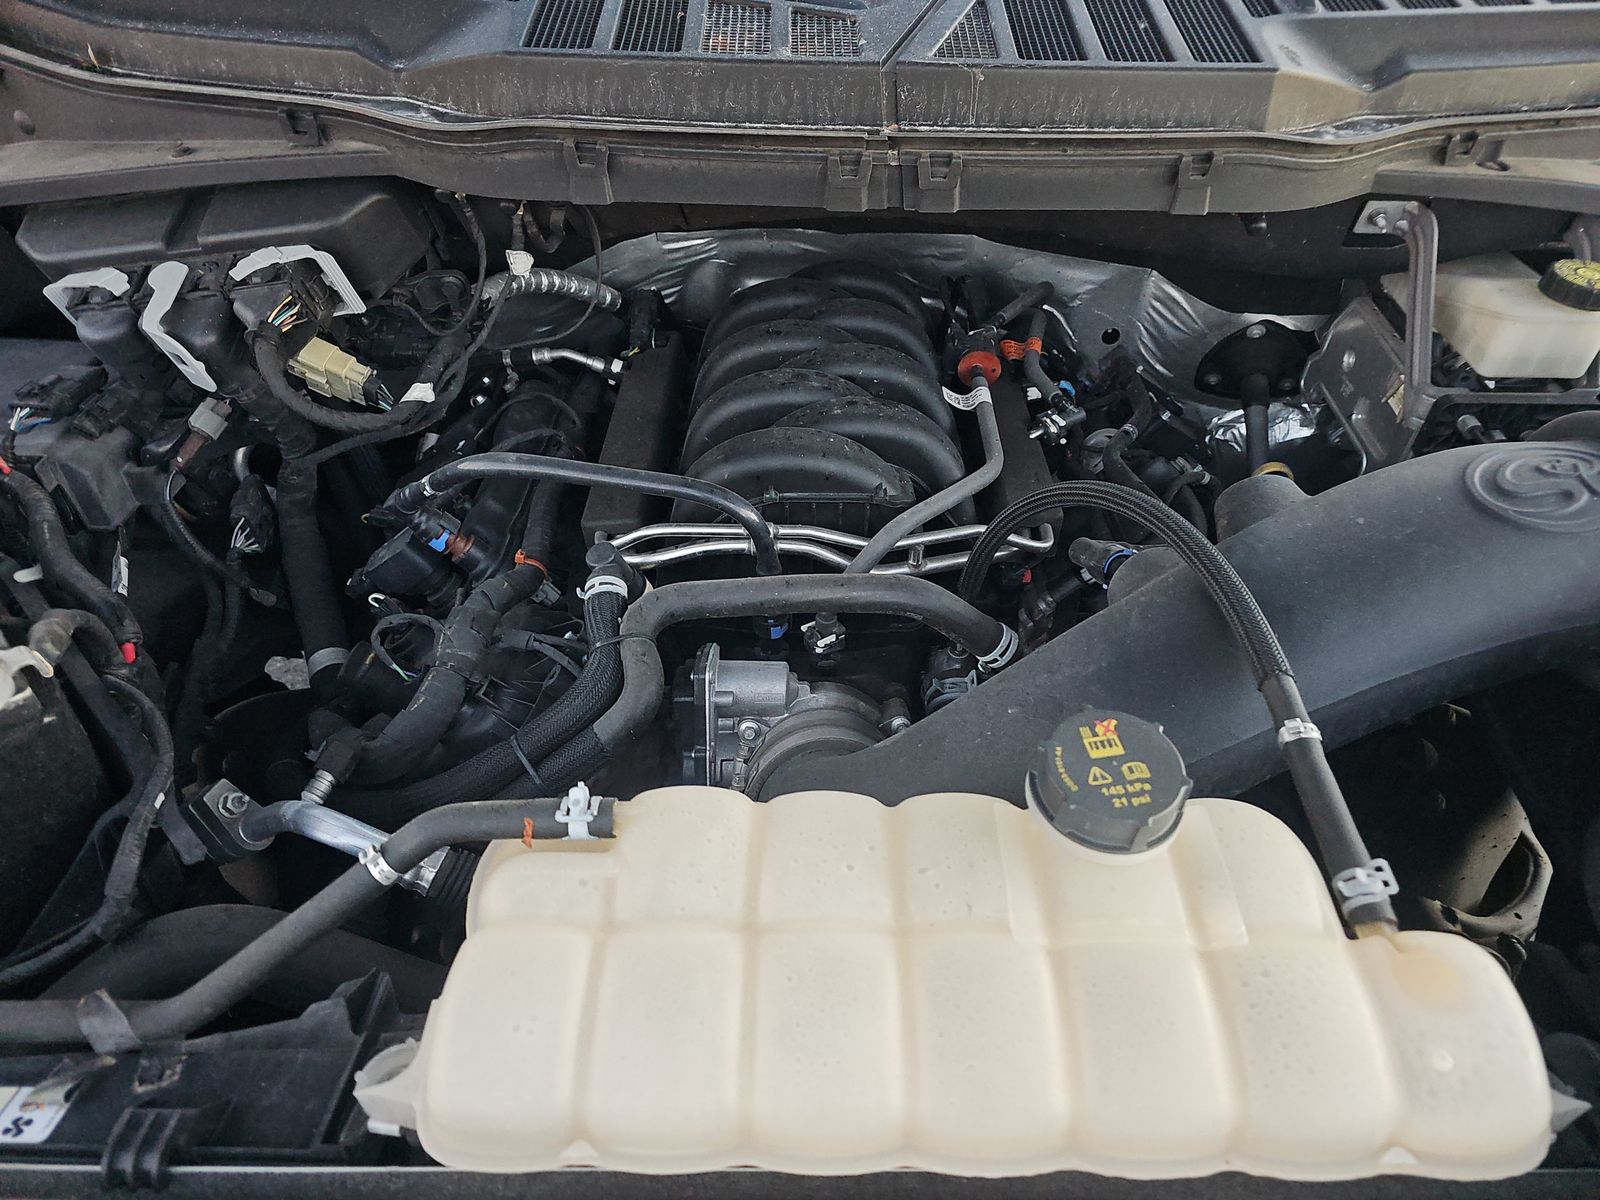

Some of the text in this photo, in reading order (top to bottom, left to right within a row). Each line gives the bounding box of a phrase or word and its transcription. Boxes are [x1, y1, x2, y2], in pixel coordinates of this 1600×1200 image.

[1102, 783, 1151, 796] 145 kPa
[1112, 794, 1151, 808] 21 psi
